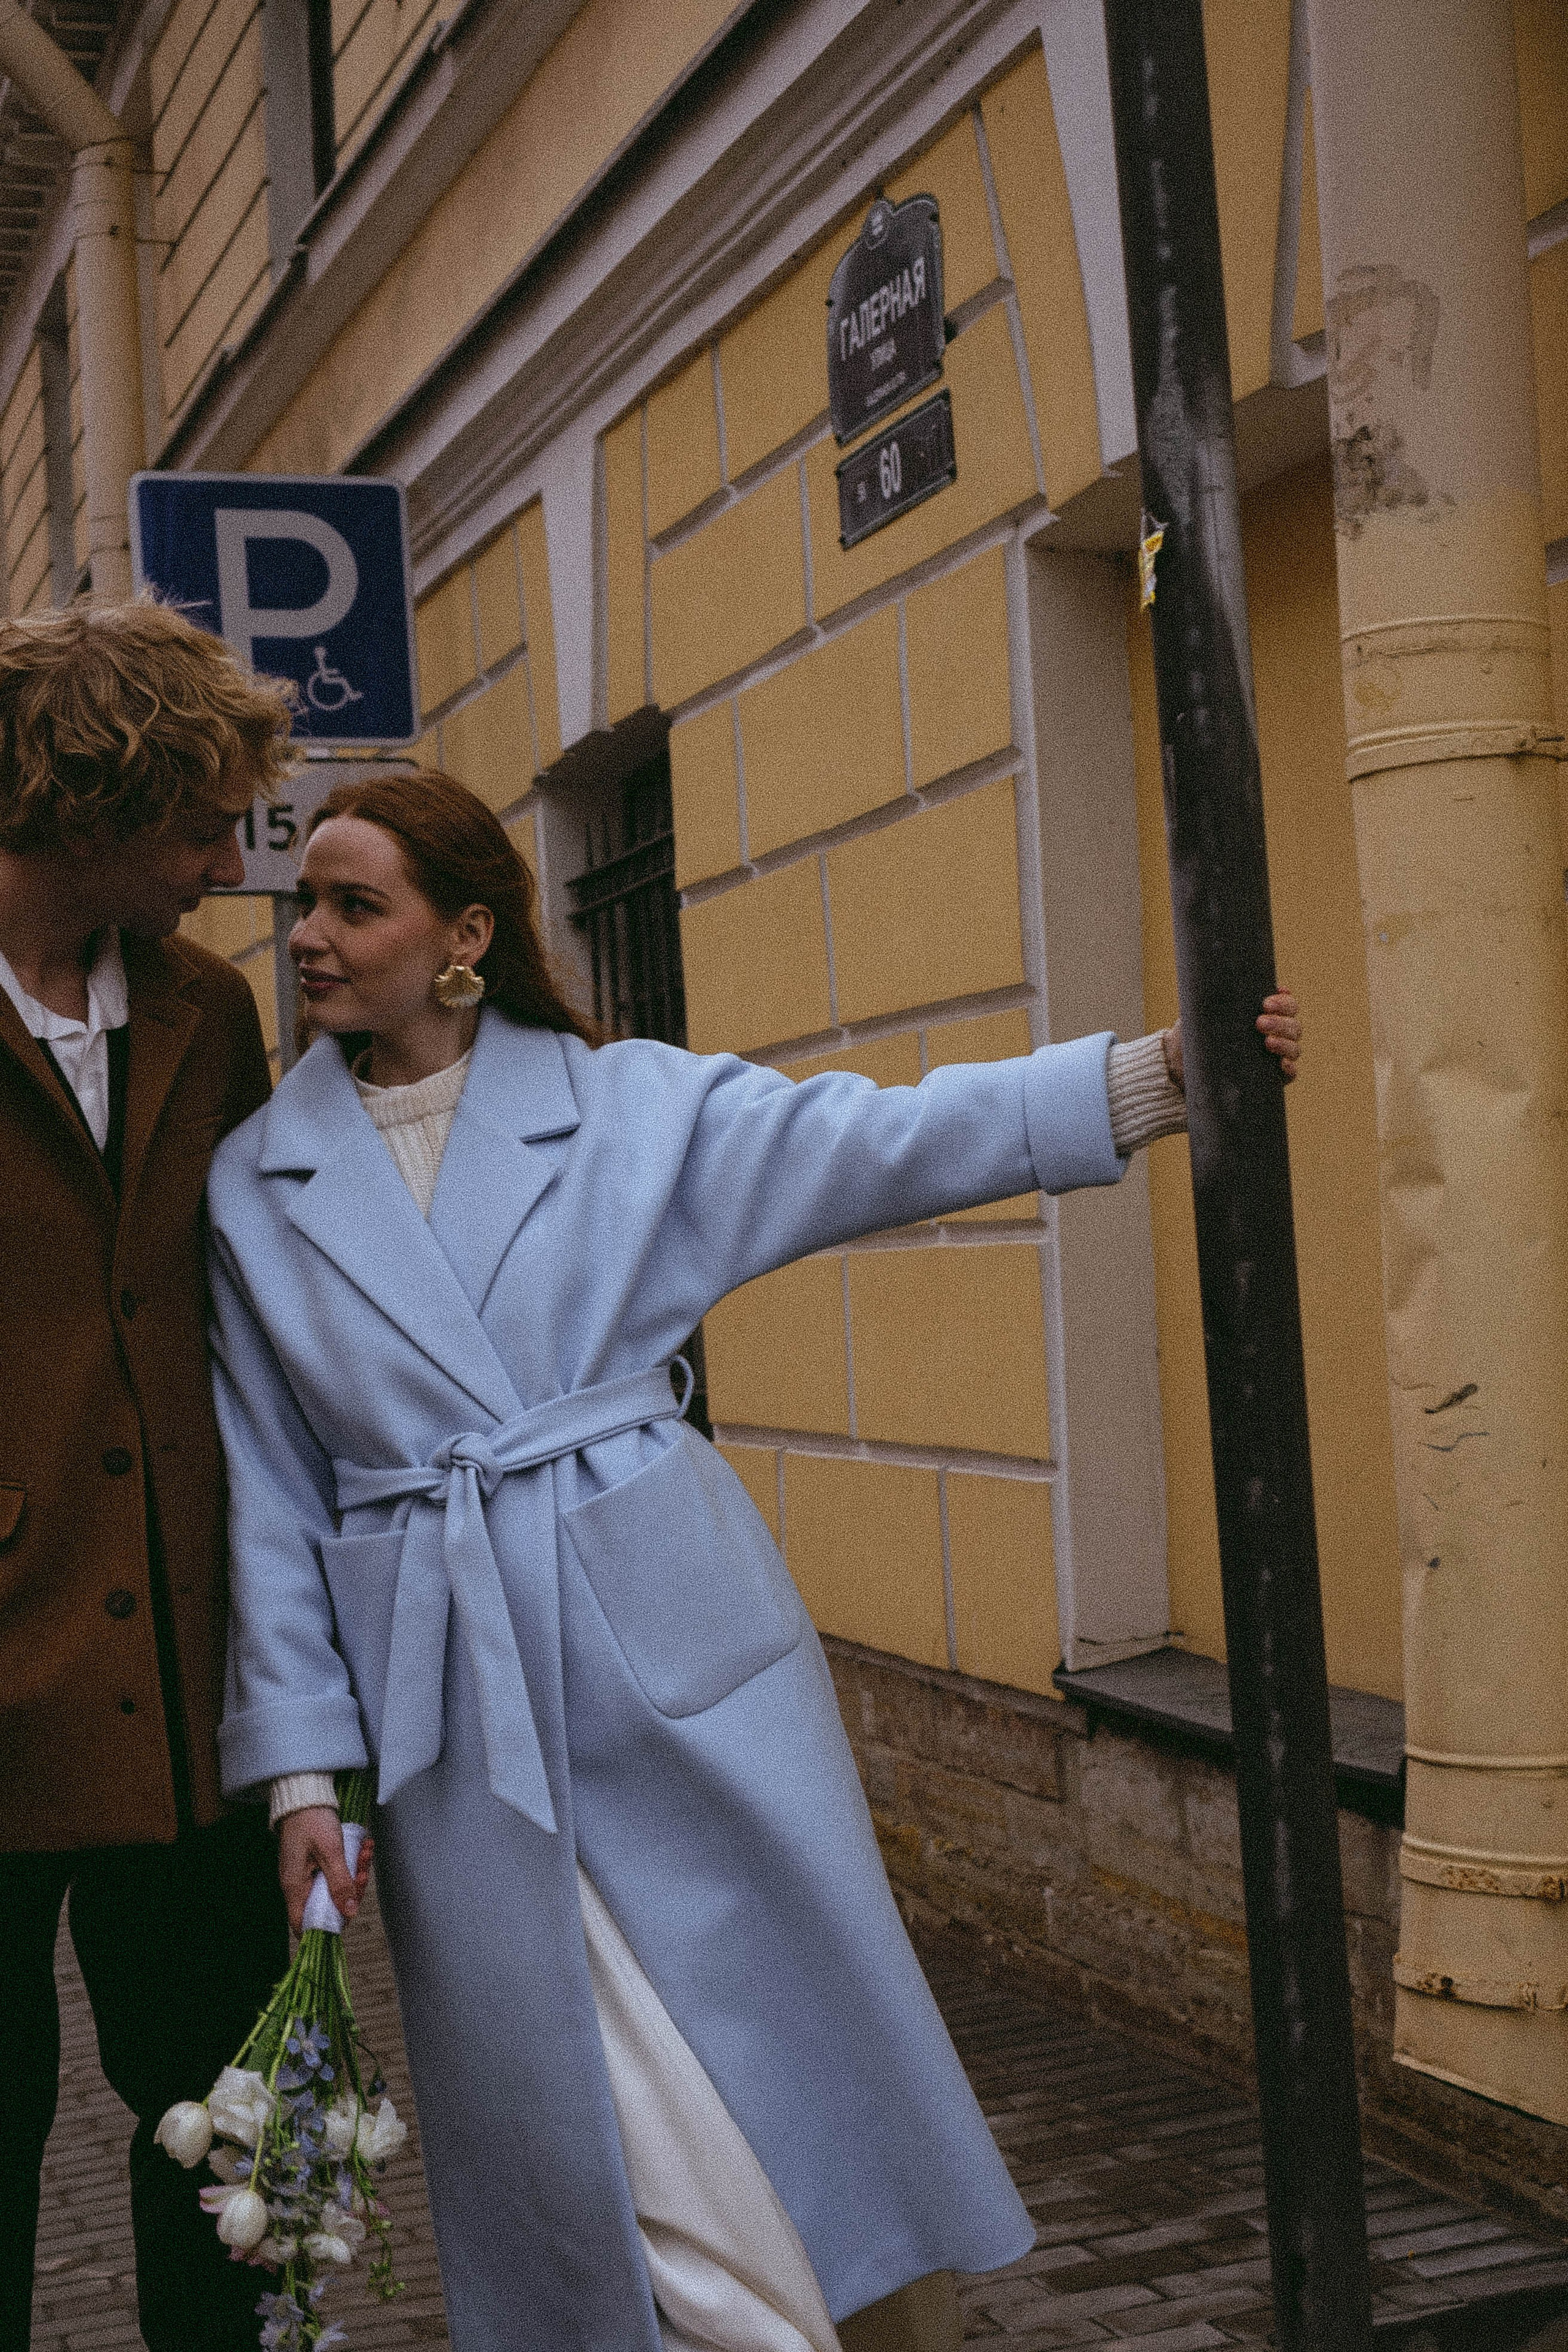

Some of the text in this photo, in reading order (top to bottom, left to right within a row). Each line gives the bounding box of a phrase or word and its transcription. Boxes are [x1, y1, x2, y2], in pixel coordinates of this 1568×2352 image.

[840, 256, 926, 361] ГАЛЕРНАЯ
[880, 440, 902, 500] 60
[214, 508, 359, 685] P
[245, 805, 296, 850] 15
